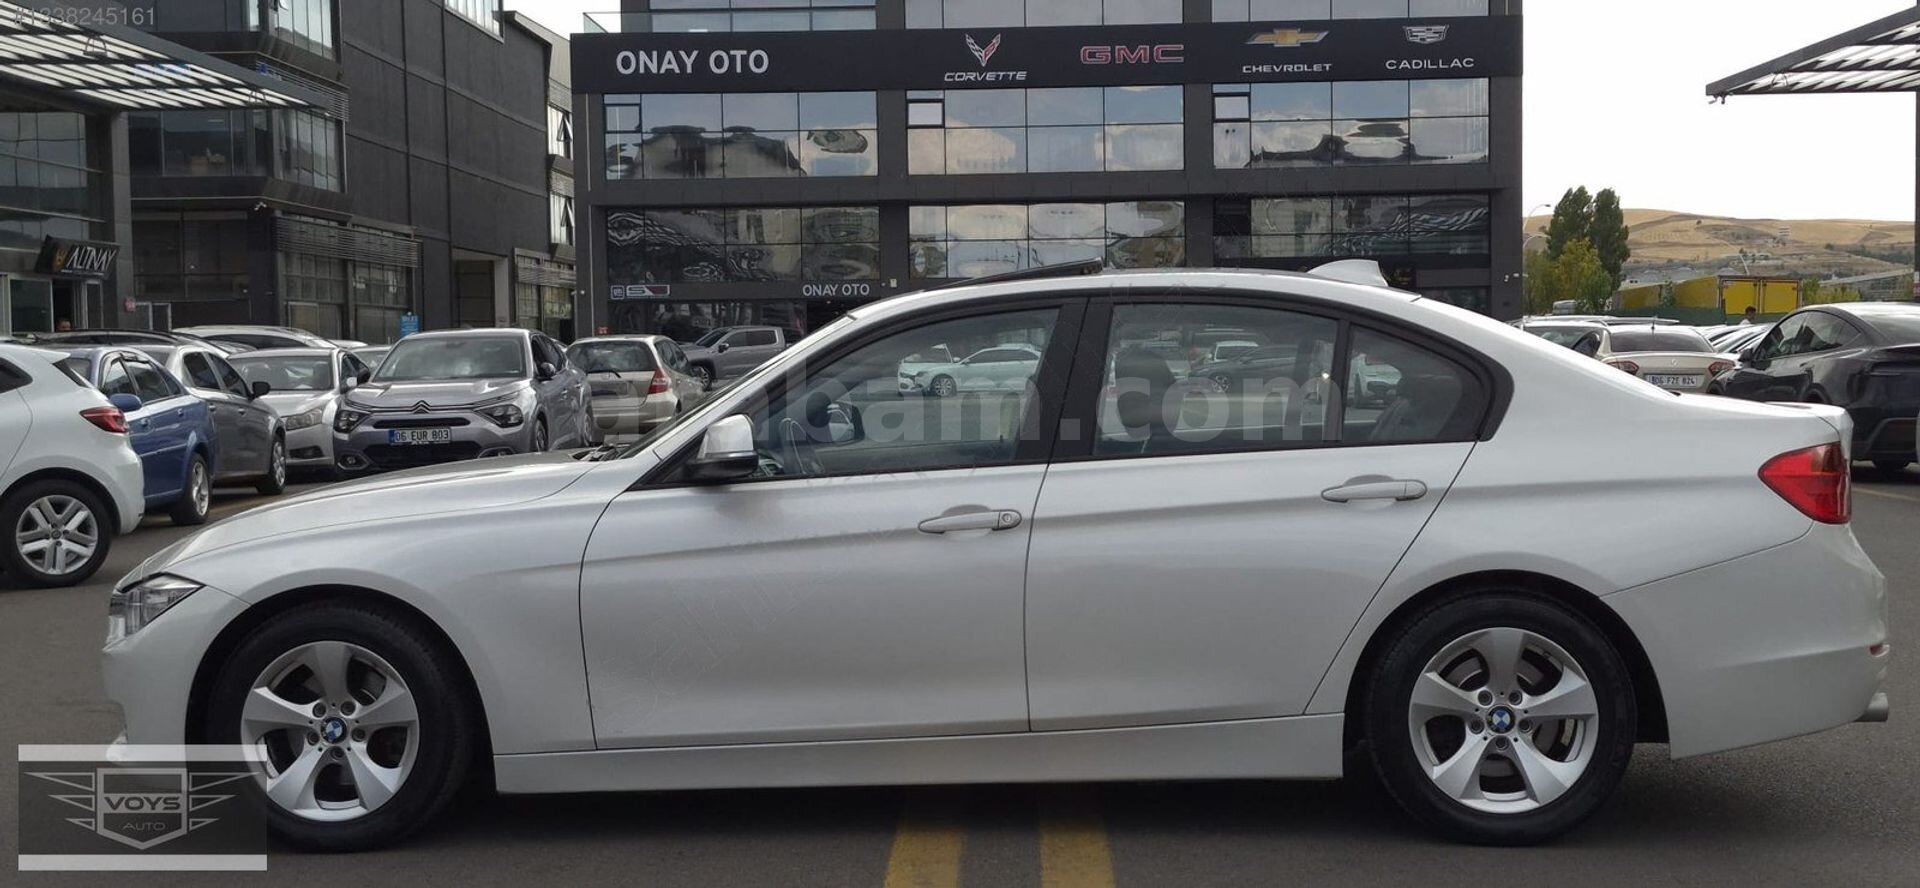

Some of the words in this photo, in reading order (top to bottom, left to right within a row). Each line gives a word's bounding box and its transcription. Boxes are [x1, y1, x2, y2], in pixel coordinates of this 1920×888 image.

[1080, 44, 1184, 65] GMC
[616, 50, 698, 75] ONAY
[709, 50, 769, 75] OTO
[1242, 63, 1332, 74] CHEVROLET
[1385, 58, 1474, 70] CADILLAC
[944, 71, 1027, 82] CORVETTE
[802, 284, 839, 296] ONAY
[841, 283, 870, 296] OTO
[411, 430, 428, 440] EUR
